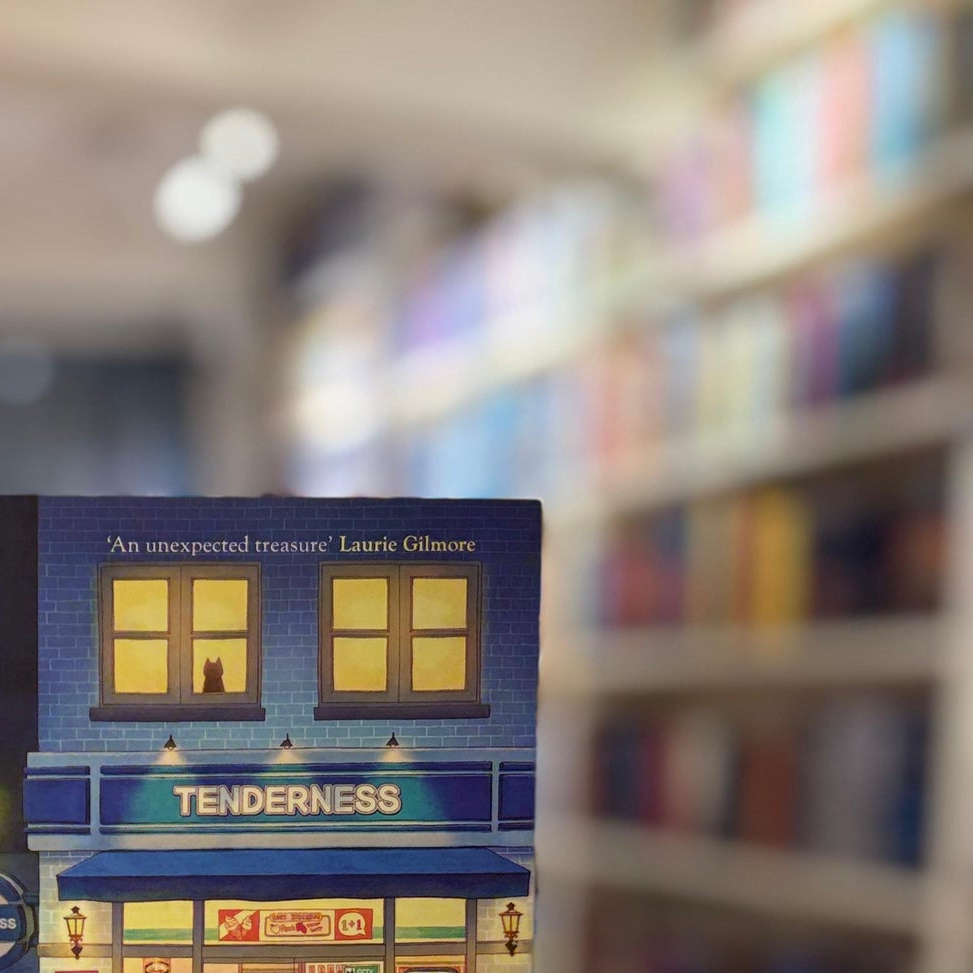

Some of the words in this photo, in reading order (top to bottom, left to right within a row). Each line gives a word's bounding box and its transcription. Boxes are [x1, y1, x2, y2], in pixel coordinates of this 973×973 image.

[145, 536, 249, 556] unexpected
[339, 535, 397, 552] Laurie
[402, 535, 476, 552] Gilmore
[173, 784, 403, 818] TENDERNESS
